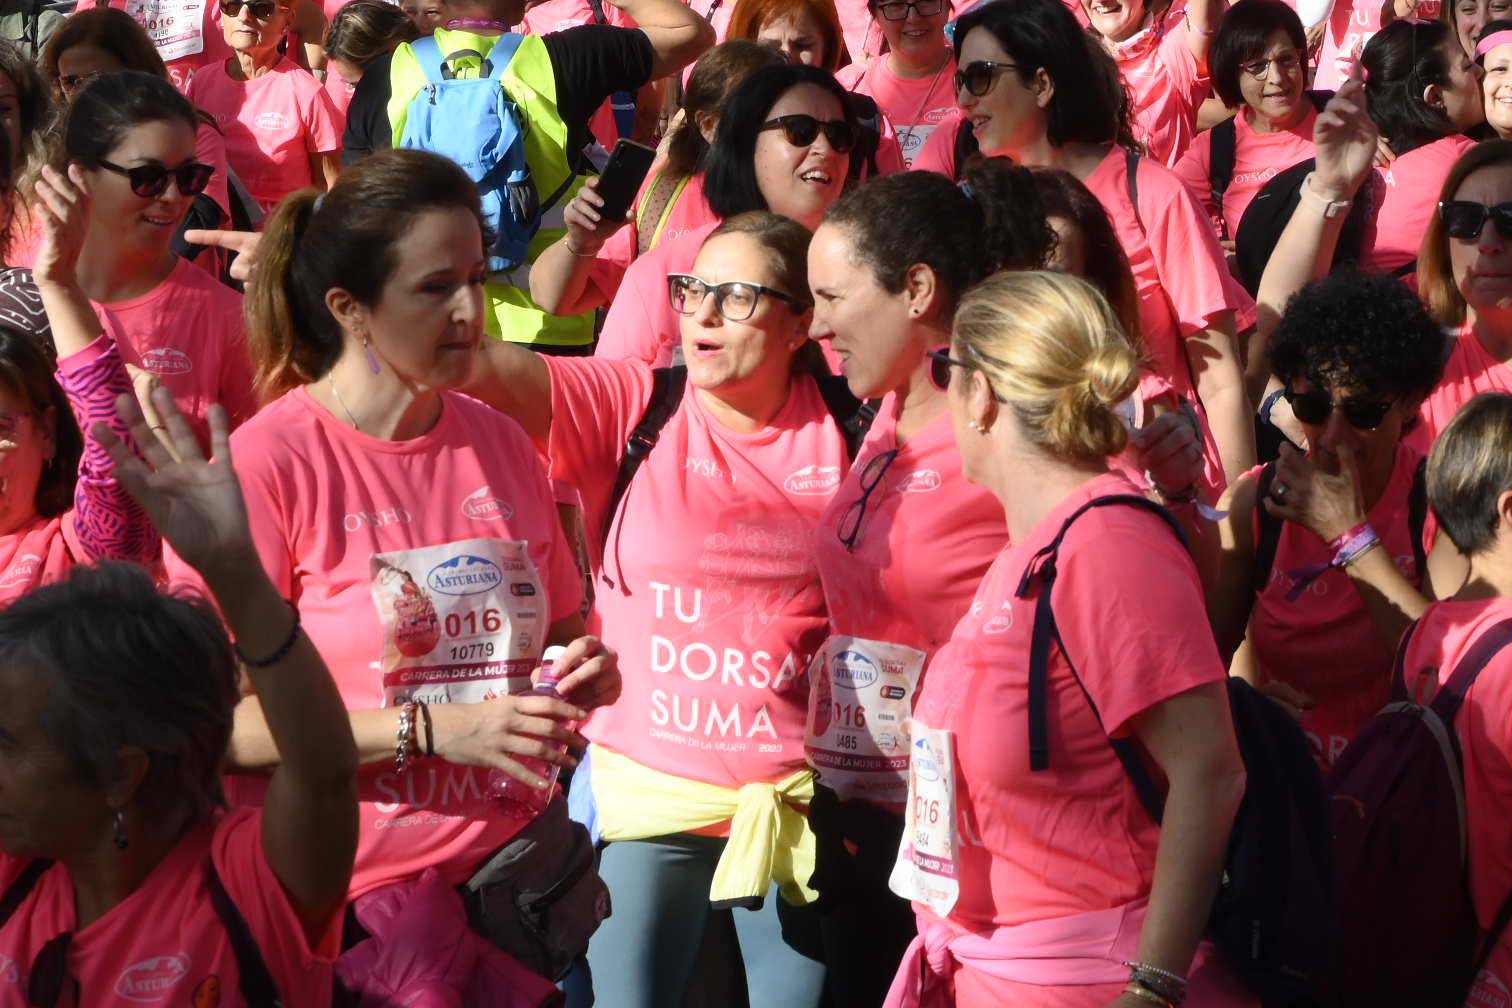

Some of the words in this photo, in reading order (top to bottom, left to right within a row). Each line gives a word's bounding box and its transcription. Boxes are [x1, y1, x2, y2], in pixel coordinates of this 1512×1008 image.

[435, 573, 498, 589] ASTURIANA
[649, 582, 702, 624] TU
[450, 642, 494, 660] 10779
[651, 635, 803, 690] DORSA
[400, 668, 449, 682] CARRERA
[450, 668, 466, 678] DE
[468, 666, 483, 677] LA
[651, 689, 778, 740] SUMA
[374, 767, 481, 813] SUM
